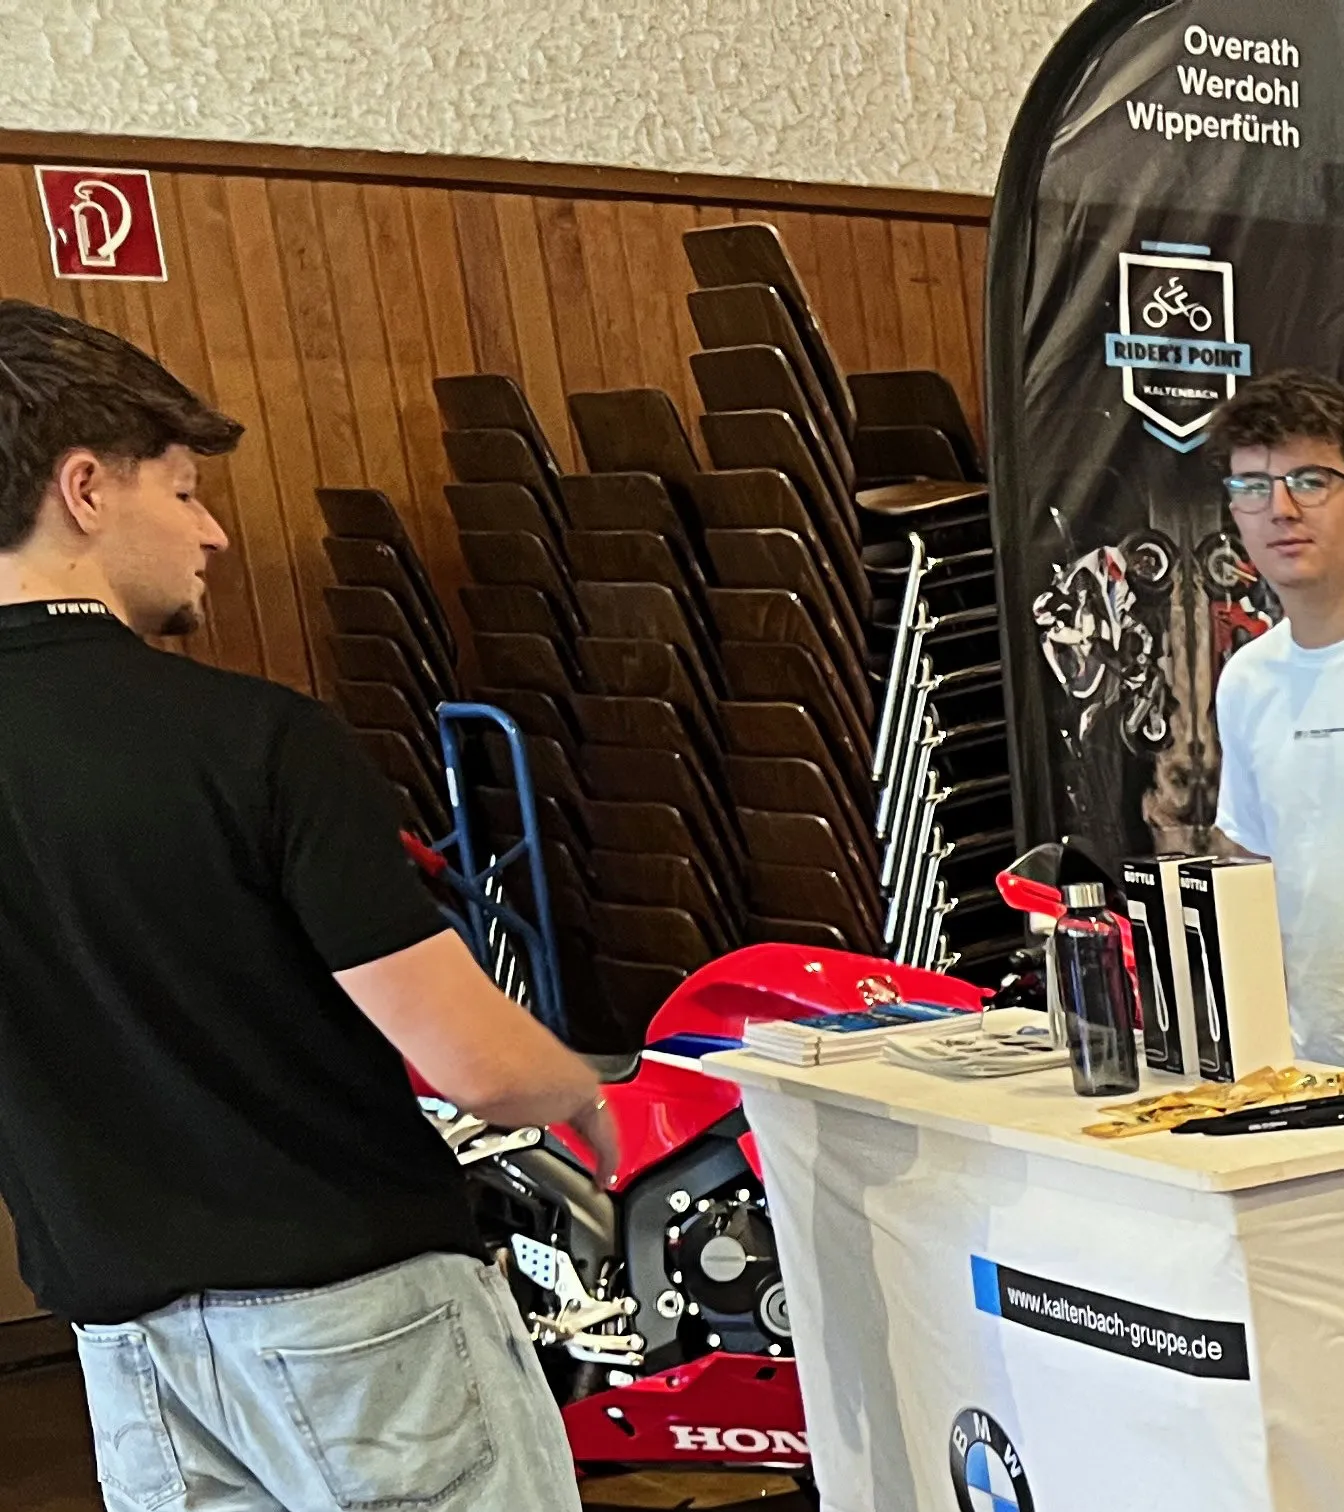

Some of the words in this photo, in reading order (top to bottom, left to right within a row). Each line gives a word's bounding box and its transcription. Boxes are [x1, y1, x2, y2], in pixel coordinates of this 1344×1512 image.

[1184, 25, 1299, 68] Overath
[1177, 66, 1299, 108] Werdohl
[1126, 100, 1299, 148] Wipperfürth
[1114, 341, 1182, 365] RIDER'S
[1188, 349, 1243, 369] POINT
[1143, 384, 1219, 400] KALTENBACH
[1007, 1285, 1224, 1362] www.kaltenbach-gruppe.de
[669, 1425, 811, 1454] HON
